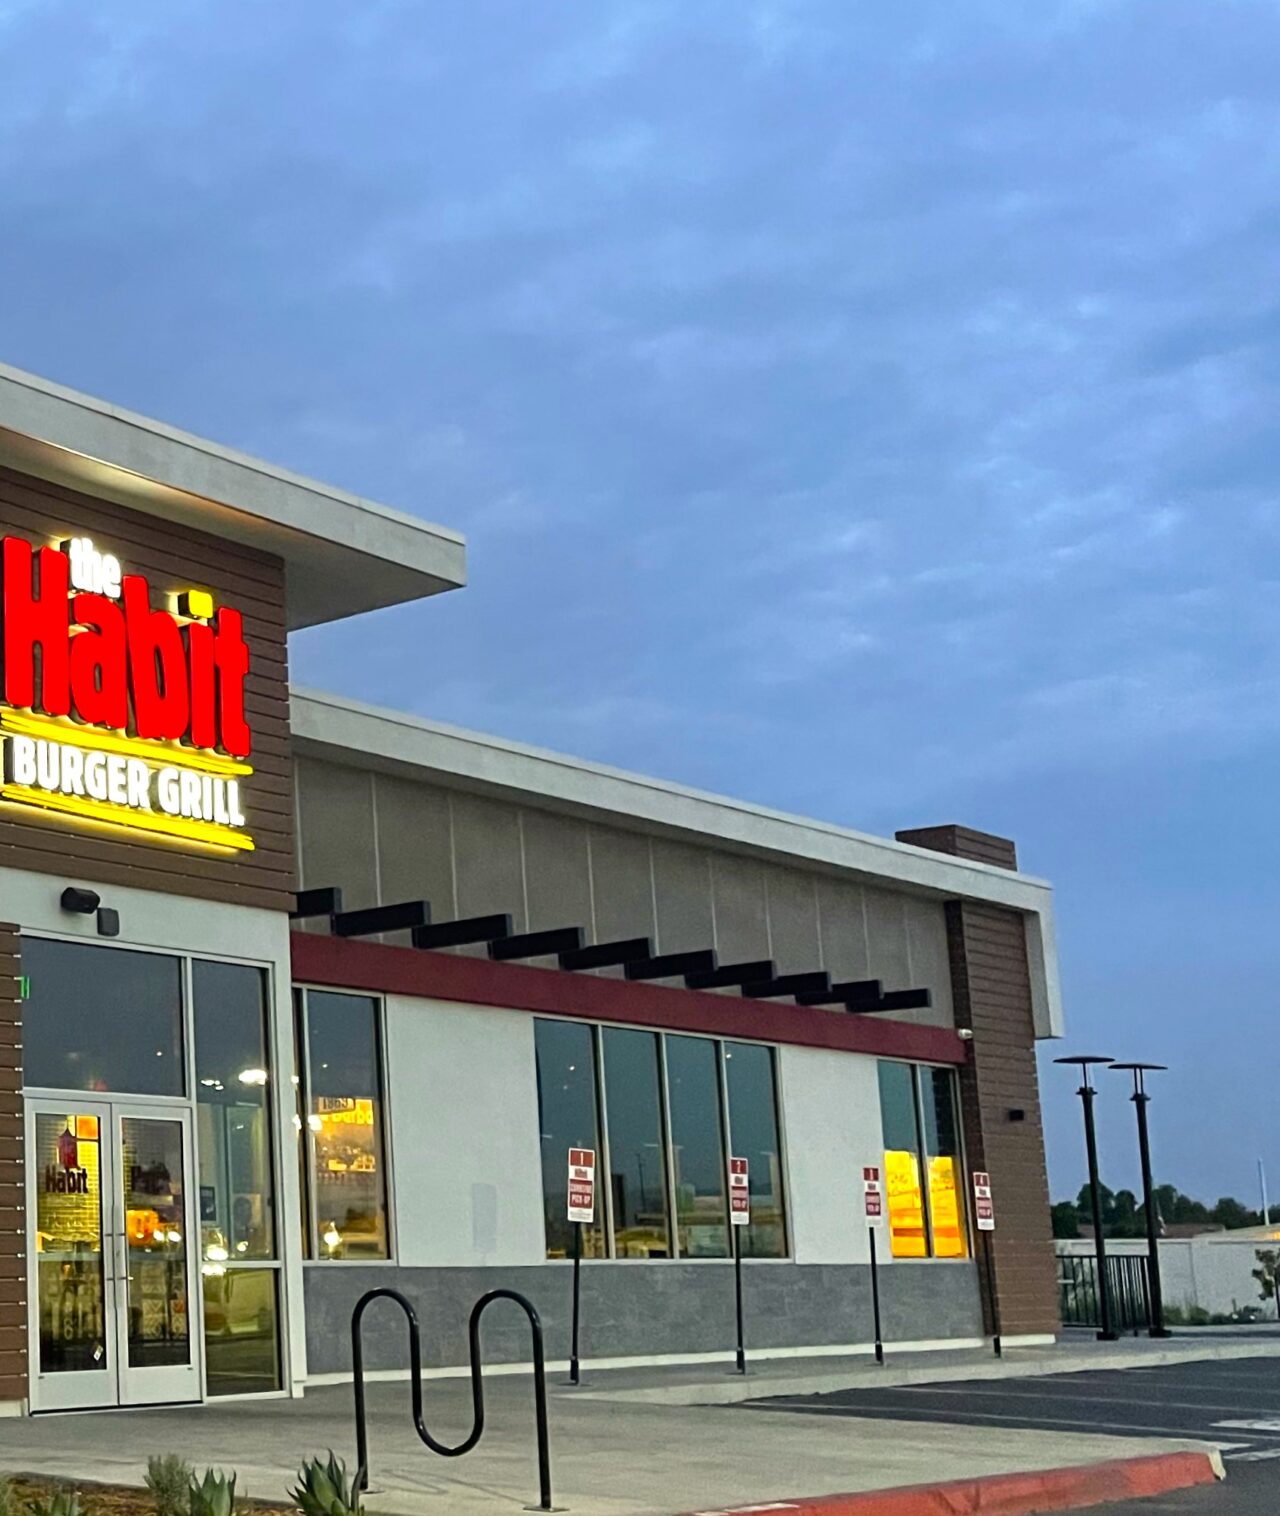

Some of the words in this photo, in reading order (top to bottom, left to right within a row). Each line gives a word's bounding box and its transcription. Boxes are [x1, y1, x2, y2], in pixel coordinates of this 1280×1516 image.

[68, 537, 121, 599] the
[2, 535, 251, 758] Habit
[12, 735, 151, 809] BURGER
[157, 766, 246, 827] GRILL
[45, 1164, 88, 1194] Habit
